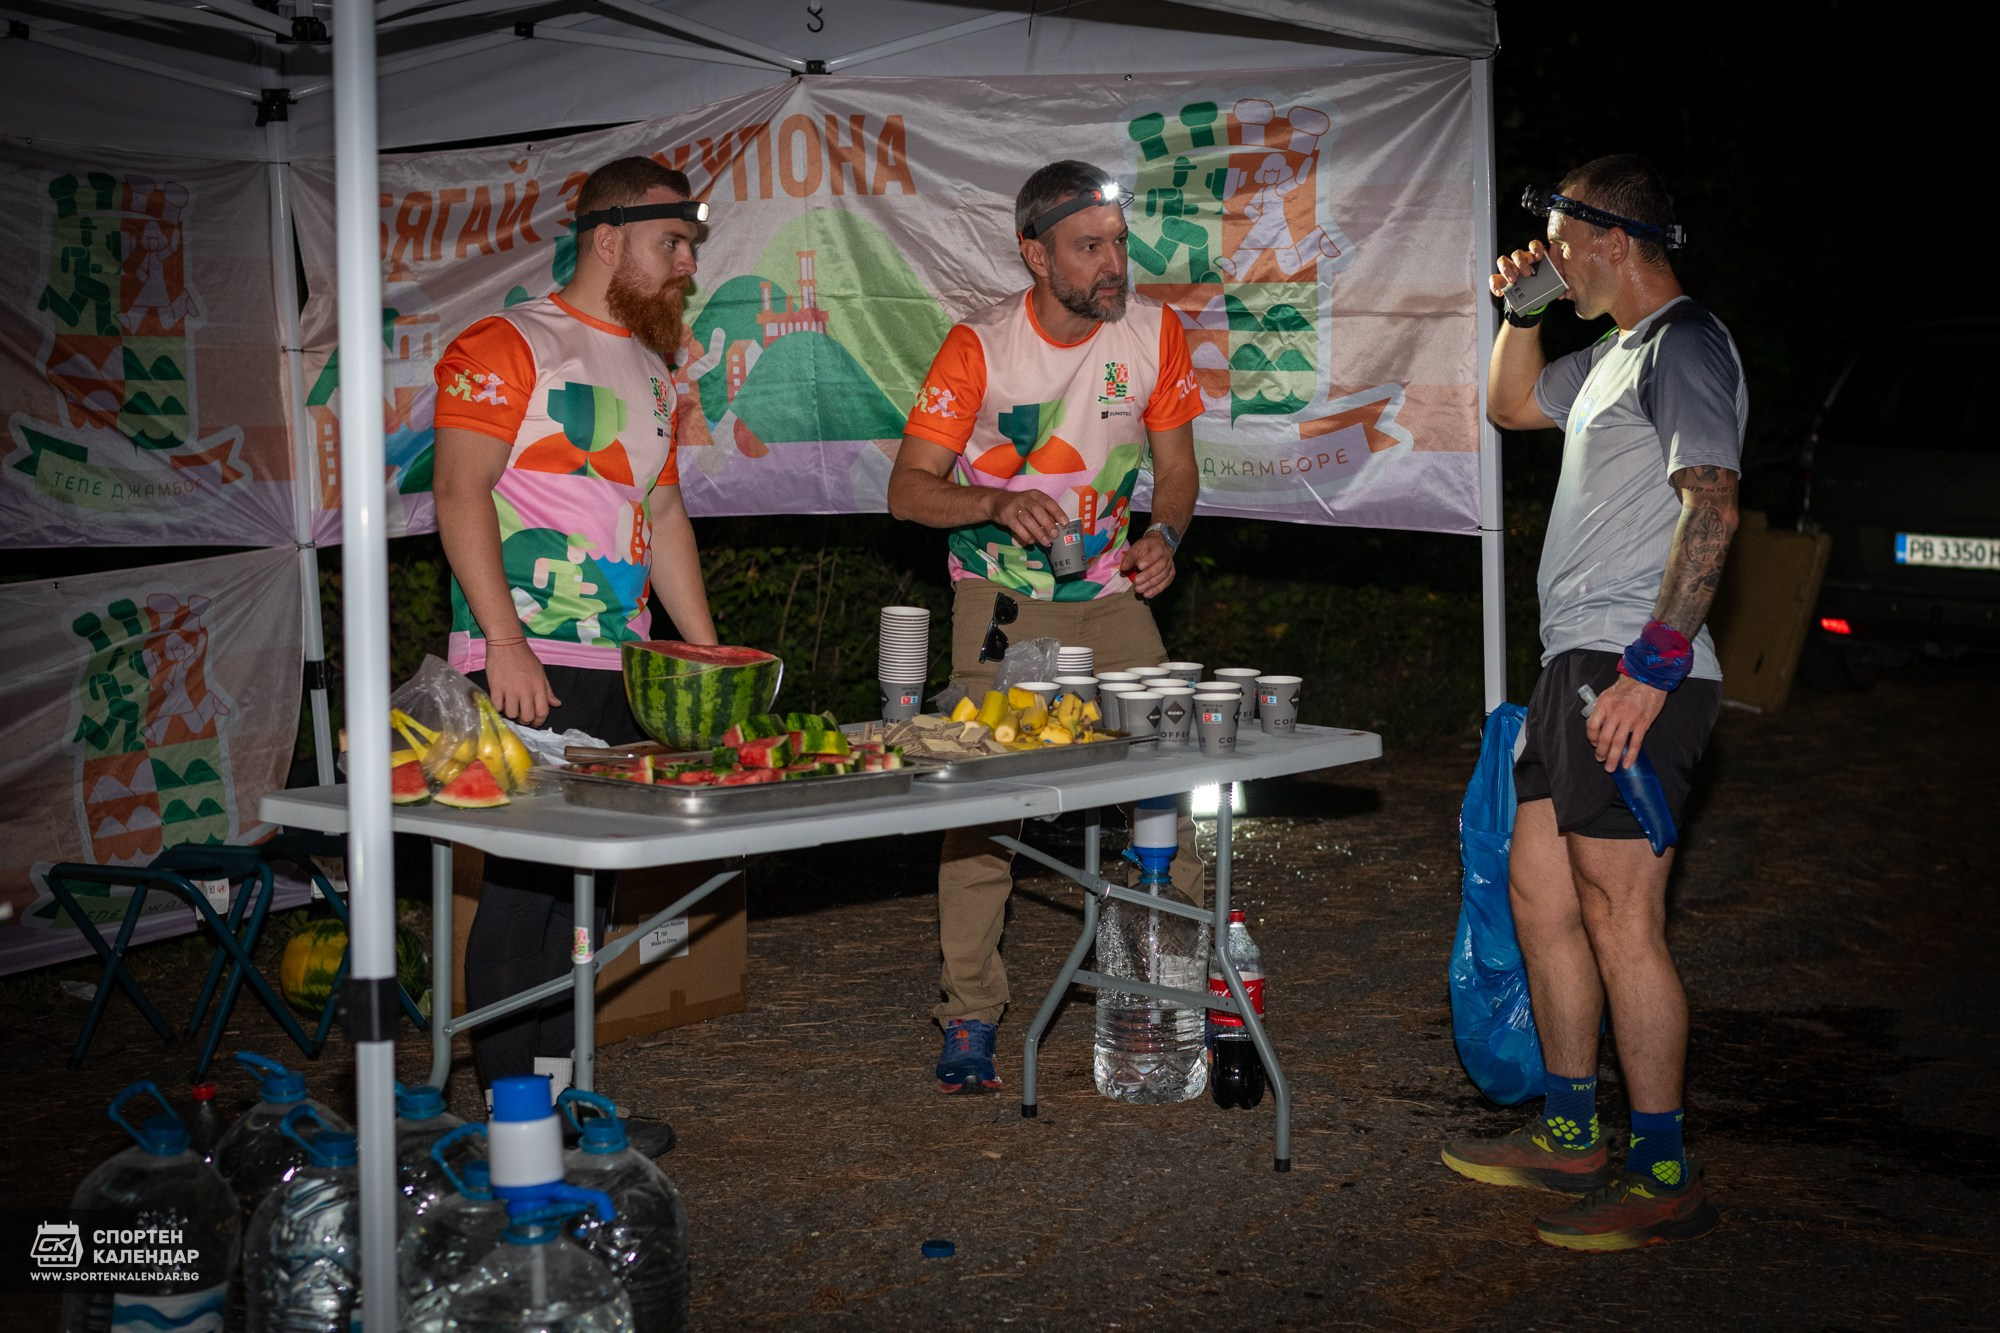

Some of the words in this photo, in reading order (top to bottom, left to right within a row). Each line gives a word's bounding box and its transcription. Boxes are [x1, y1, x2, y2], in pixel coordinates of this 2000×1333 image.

[1177, 369, 1197, 400] 202
[1203, 448, 1349, 476] ДЖАМБОРЕ
[55, 472, 102, 495] ТЕПЕ
[112, 478, 200, 500] ДЖАМБО
[1940, 541, 1987, 563] 3350
